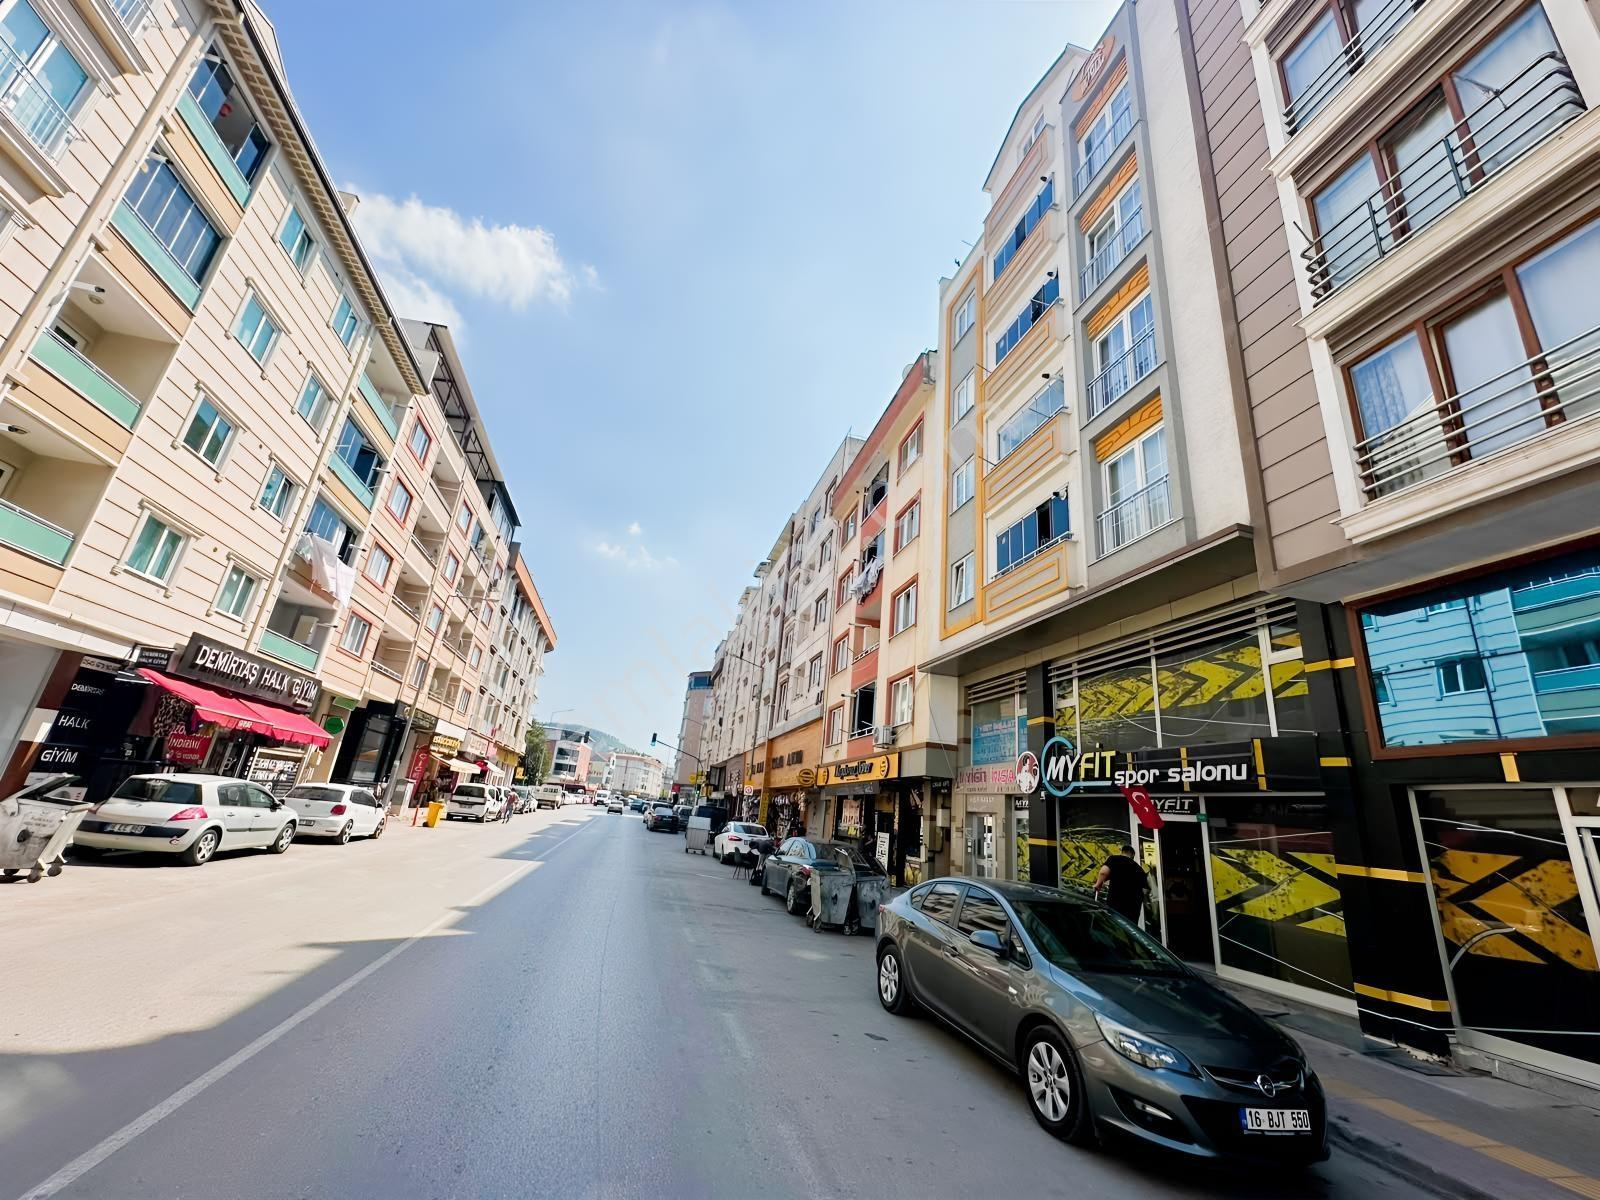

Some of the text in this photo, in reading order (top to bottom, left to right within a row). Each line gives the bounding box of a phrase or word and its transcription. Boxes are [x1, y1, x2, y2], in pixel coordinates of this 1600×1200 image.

[195, 645, 318, 701] DEMİRTAŞ HALK GİYİM
[58, 714, 90, 730] HALK
[40, 747, 78, 763] GİYİM
[1114, 769, 1159, 789] spor
[1168, 760, 1247, 783] salonu
[1151, 796, 1194, 811] YFİT
[1248, 1110, 1309, 1129] 16 BJT 550
